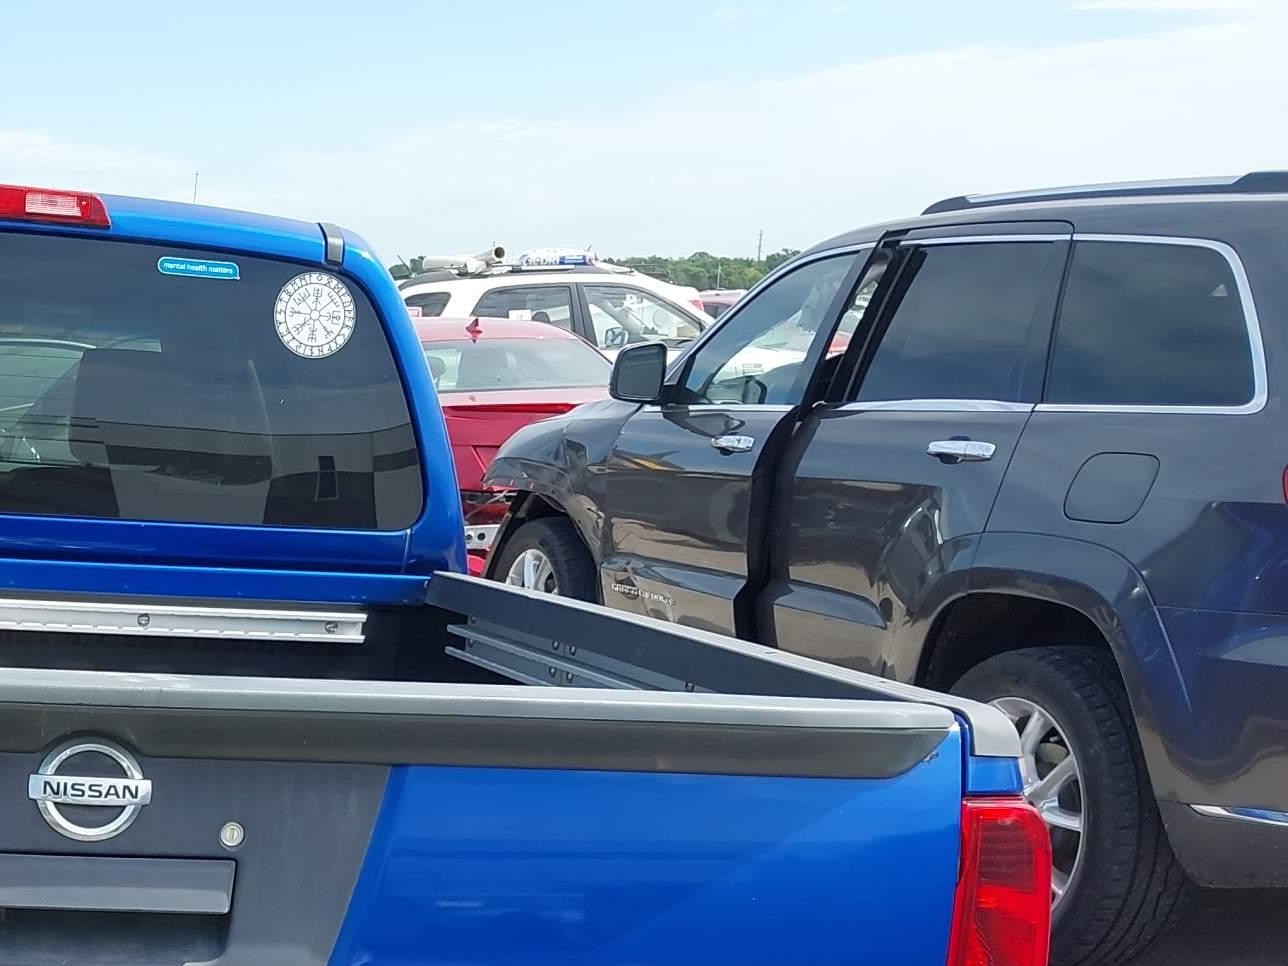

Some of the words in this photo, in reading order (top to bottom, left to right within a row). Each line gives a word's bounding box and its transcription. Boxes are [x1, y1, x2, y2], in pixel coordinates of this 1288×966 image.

[163, 262, 185, 270] mental
[186, 263, 207, 272] health
[208, 266, 233, 274] matters
[42, 780, 139, 799] NISSAN
